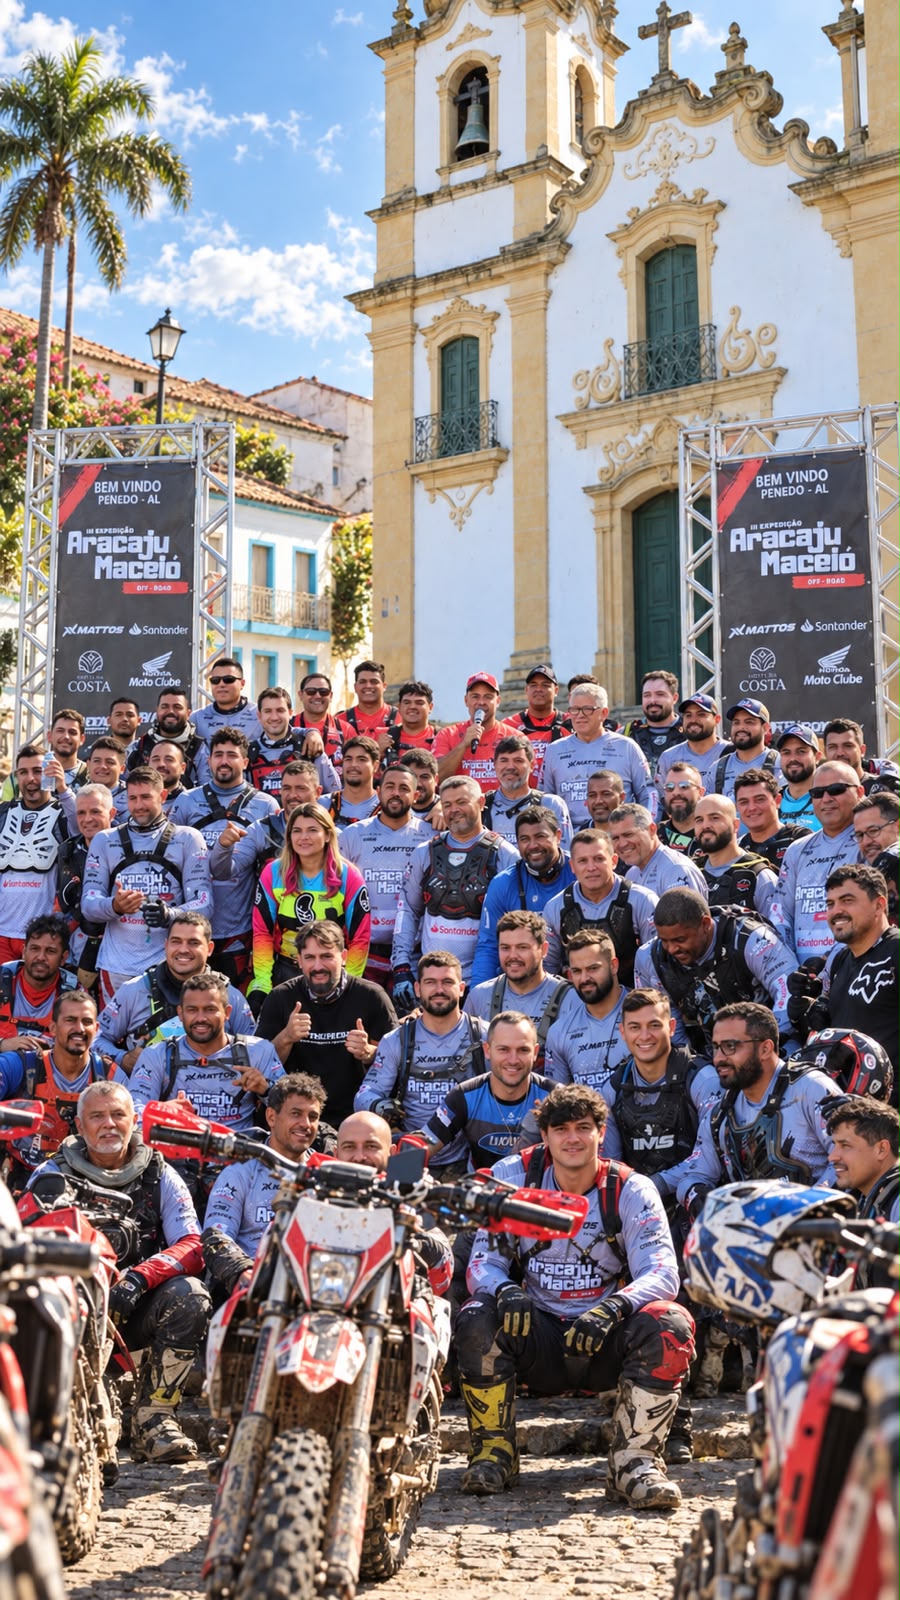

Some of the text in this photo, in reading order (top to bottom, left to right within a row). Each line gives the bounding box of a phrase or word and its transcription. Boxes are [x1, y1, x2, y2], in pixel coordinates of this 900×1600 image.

[756, 468, 828, 488] BEM VINDO
[94, 480, 162, 494] BEM VINDO
[761, 486, 805, 499] PENEDO
[815, 483, 829, 494] AL
[98, 494, 138, 505] PENEDO
[148, 494, 160, 504] AL
[760, 520, 802, 529] EXPEDIÇÃO
[730, 521, 842, 554] Aracaju
[67, 530, 170, 560] Aracaju
[94, 554, 181, 580] Maceió
[760, 546, 856, 576] Maceió
[142, 625, 188, 636] Santander
[815, 620, 868, 632] Santander
[68, 680, 111, 692] COSTA
[128, 677, 181, 687] Moto Clube
[739, 678, 786, 692] COSTA
[804, 673, 863, 686] Moto Clube
[439, 927, 479, 936] Santander
[633, 1134, 675, 1150] IMS
[528, 1257, 592, 1279] Aracaju
[540, 1274, 602, 1290] Maceió
